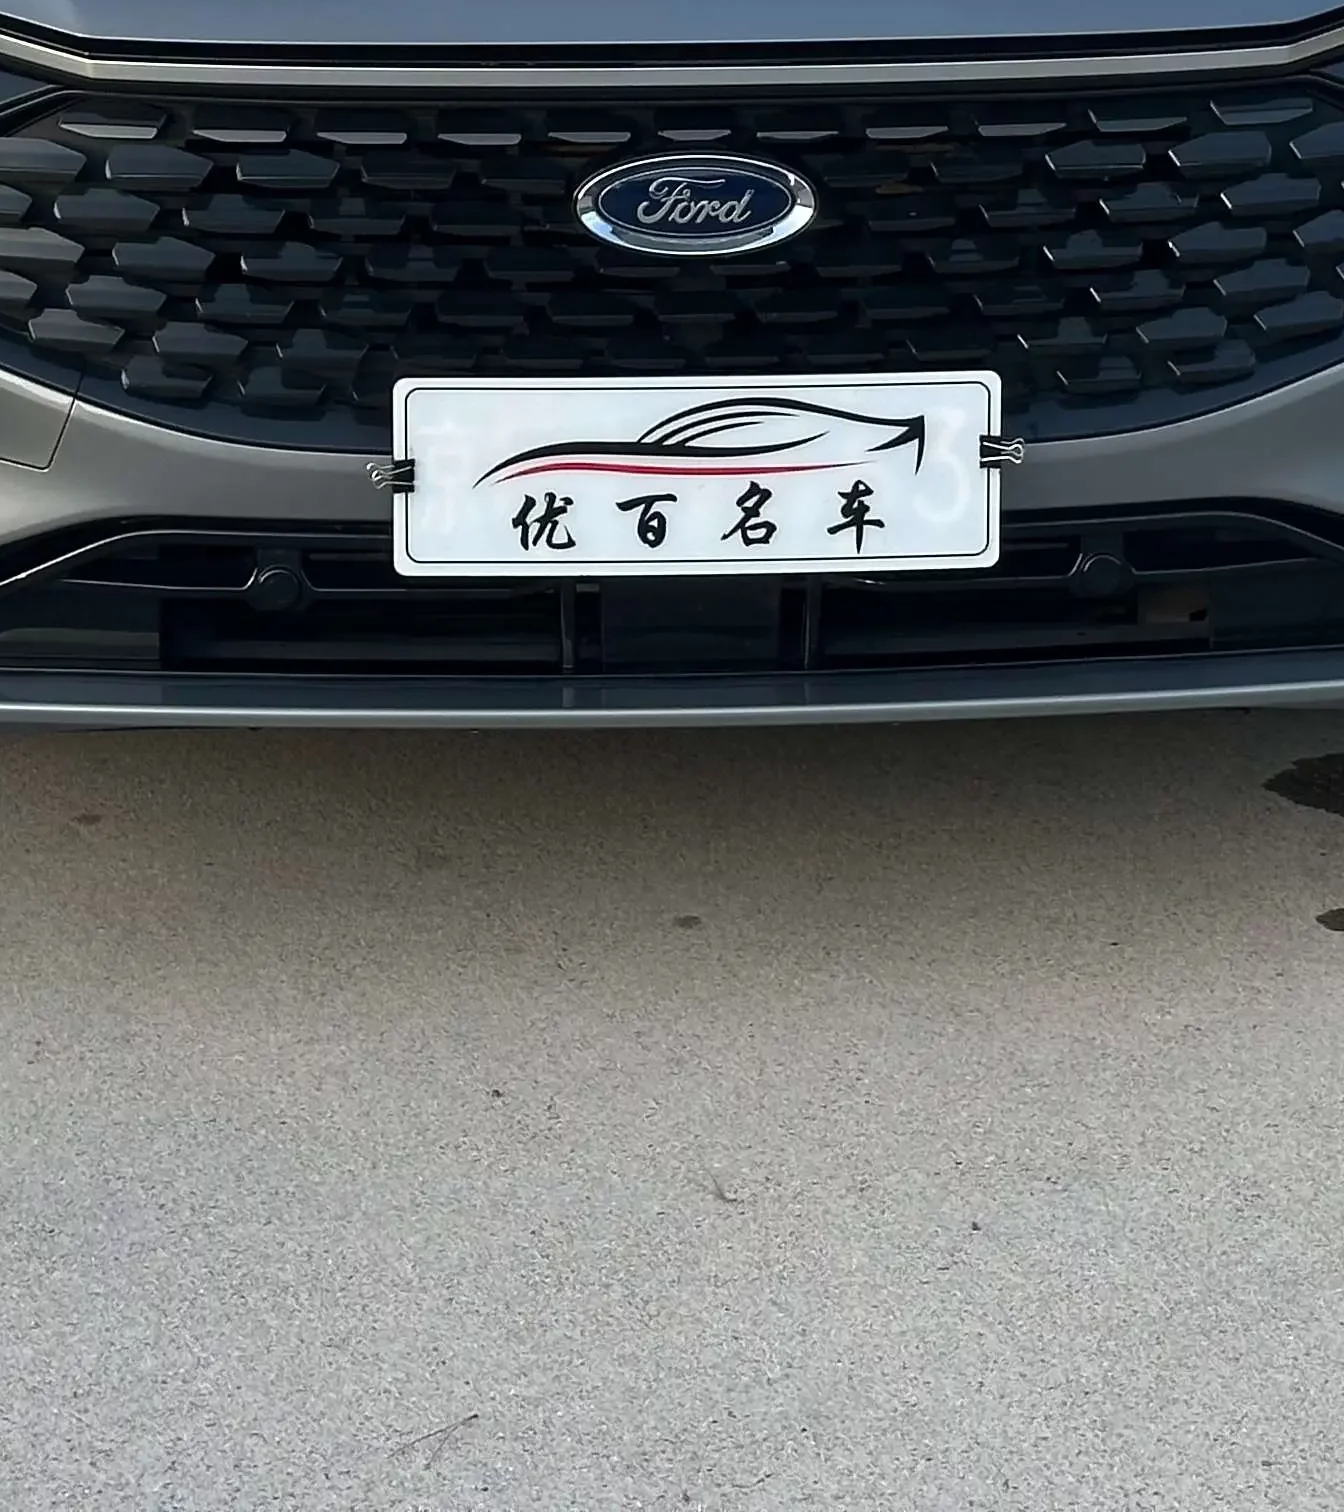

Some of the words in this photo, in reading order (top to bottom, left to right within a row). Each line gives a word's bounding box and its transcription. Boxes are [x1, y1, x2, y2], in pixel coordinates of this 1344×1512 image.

[637, 176, 755, 224] Ford
[512, 480, 886, 555] 优百名车
